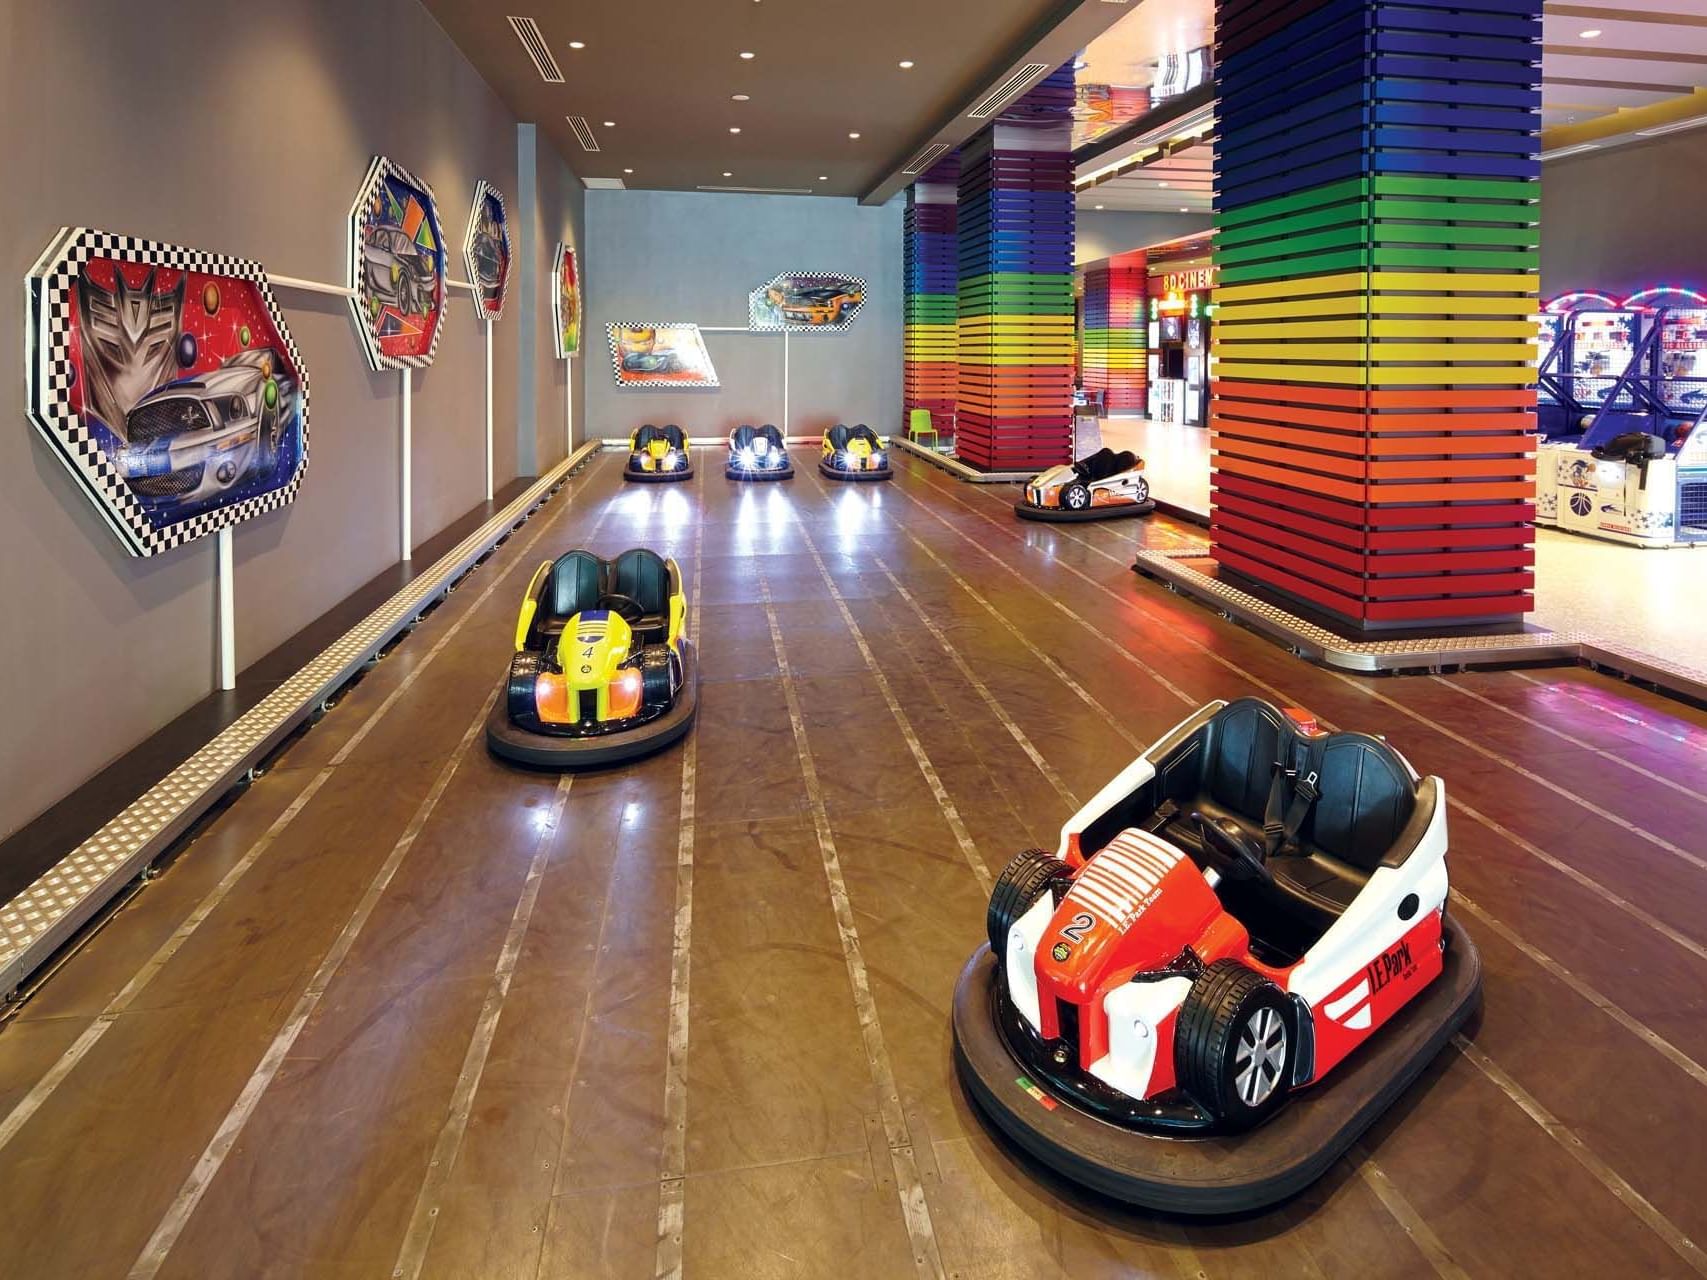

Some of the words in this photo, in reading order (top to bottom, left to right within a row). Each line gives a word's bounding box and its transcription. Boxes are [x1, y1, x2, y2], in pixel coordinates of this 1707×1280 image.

[582, 646, 594, 659] 4
[1127, 904, 1148, 923] Park
[1060, 911, 1096, 945] 2
